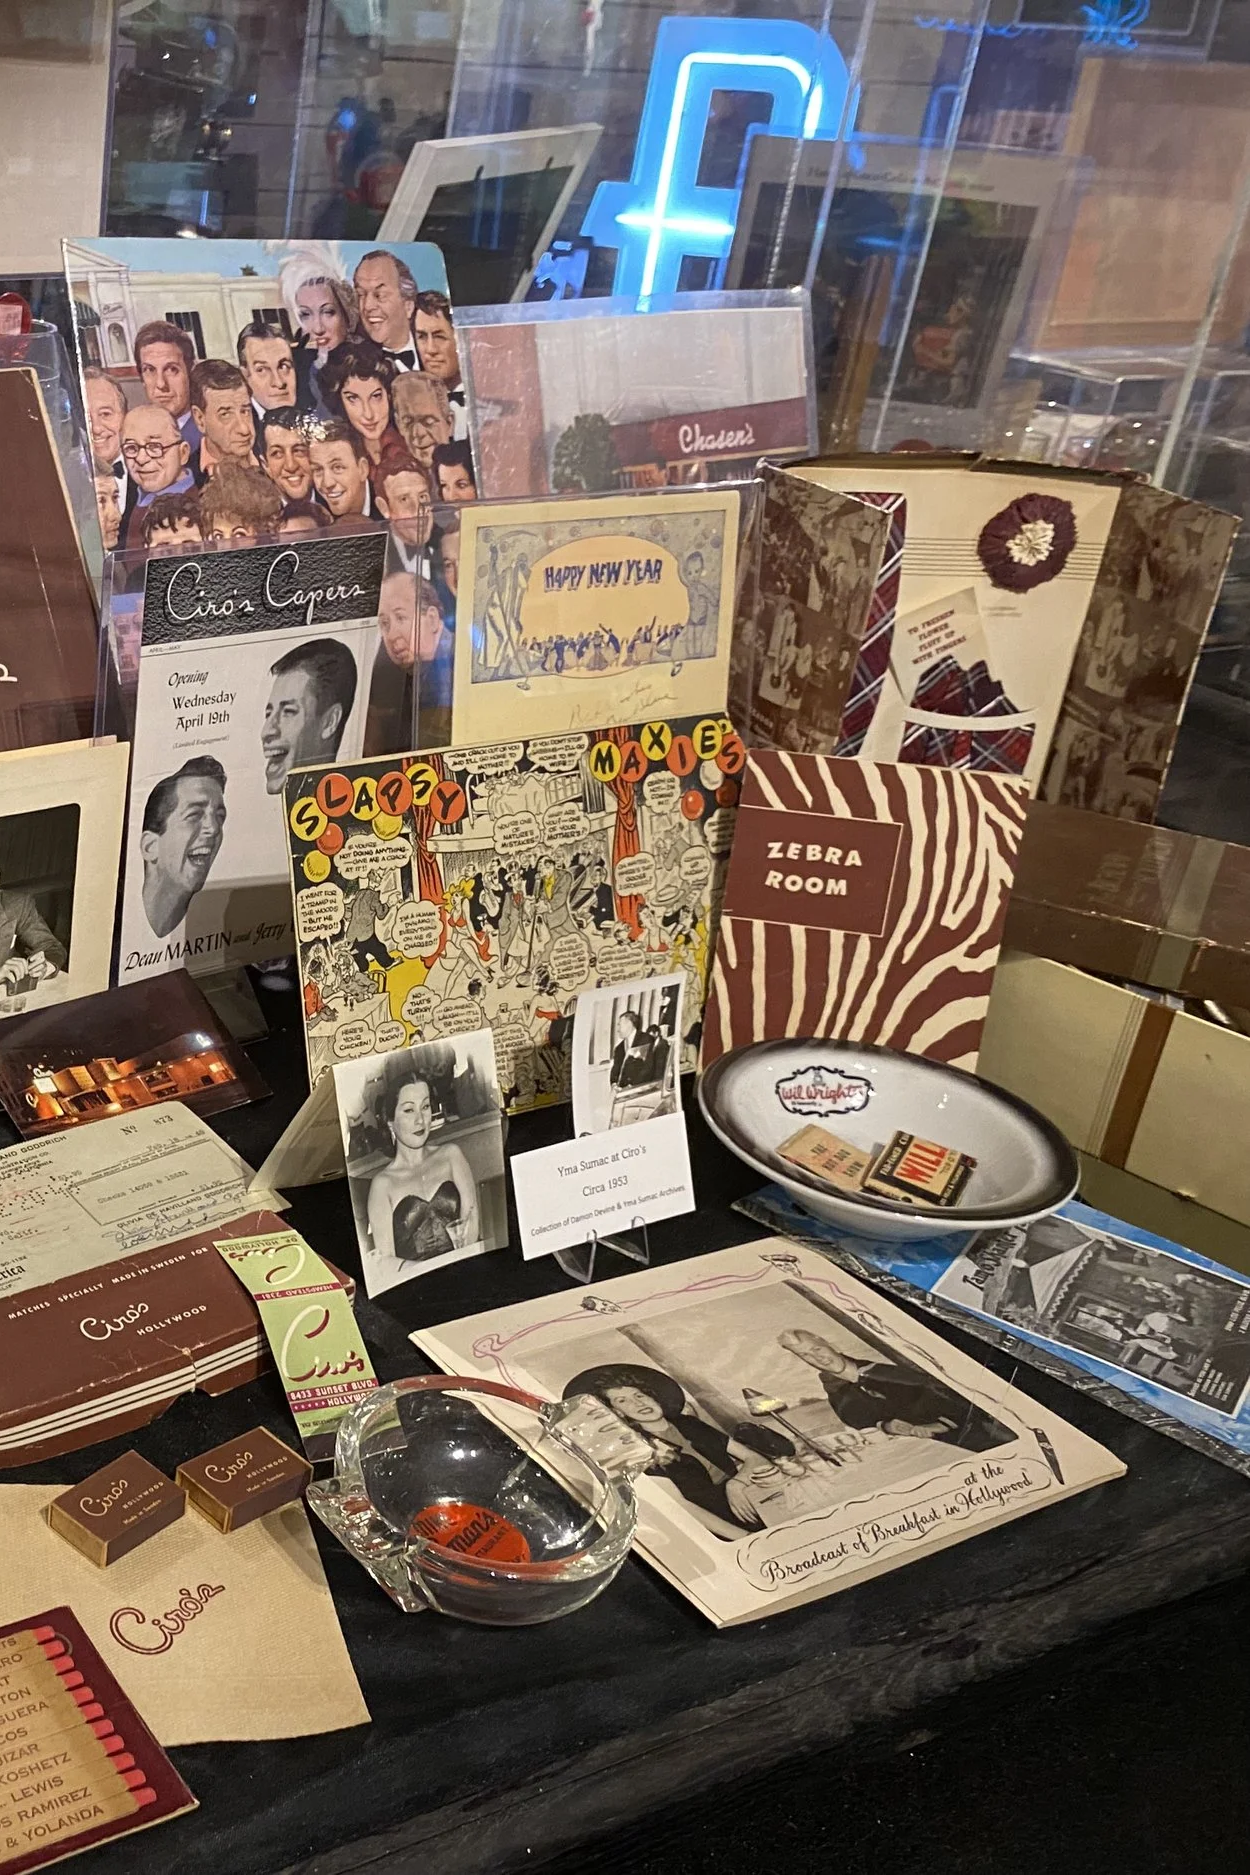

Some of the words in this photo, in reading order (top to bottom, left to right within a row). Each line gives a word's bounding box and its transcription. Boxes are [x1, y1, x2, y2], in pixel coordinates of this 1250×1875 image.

[679, 423, 755, 453] Chasen's
[167, 562, 254, 620] Ciro's
[266, 550, 365, 624] Capers
[544, 566, 586, 591] HAPPY
[588, 562, 622, 588] NEW
[624, 559, 662, 584] YEAR
[168, 670, 209, 687] Opening
[172, 691, 237, 710] Wednesday
[176, 714, 204, 730] April
[208, 711, 230, 726] 19th
[295, 768, 462, 835] SLAPSY
[767, 842, 863, 867] ZEBRA
[764, 870, 847, 896] ROOM
[125, 951, 161, 971] Dean
[164, 932, 232, 961] MARTIN
[253, 922, 286, 945] Jerry
[407, 1006, 433, 1014] TURKEY
[20, 1136, 67, 1154] GOODRICH
[557, 1165, 579, 1178] Yma
[580, 1155, 609, 1172] Sumac
[611, 1153, 620, 1162] at
[621, 1144, 647, 1159] Ciro's
[582, 1182, 606, 1197] Circa
[608, 1175, 629, 1189] 1953
[531, 1221, 562, 1237] Collection
[563, 1218, 570, 1226] of
[571, 1211, 594, 1224] Damon
[594, 1205, 616, 1217] Devine
[623, 1199, 637, 1208] Yma
[638, 1192, 658, 1204] Sumac
[659, 1185, 686, 1198] Archives
[8, 1302, 51, 1320] MATCHES
[58, 1282, 104, 1303] SPECIALLY
[111, 1272, 137, 1284] MADE
[138, 1267, 149, 1276] IN
[150, 1254, 186, 1271] SWEDEN
[191, 1246, 209, 1257] FOR
[79, 1302, 149, 1341] Ciro's
[137, 1304, 208, 1336] HOLLYWOOD
[281, 1304, 365, 1383] Ciro's
[290, 1389, 313, 1401] 8433
[316, 1383, 349, 1396] SUNSET
[351, 1379, 376, 1391] BLVD.
[204, 1451, 253, 1483] Ciro's
[246, 1456, 288, 1479] HOLLYWOOD
[964, 1471, 979, 1487] at
[982, 1463, 1005, 1480] the
[79, 1478, 129, 1517] Ciro's
[122, 1481, 165, 1509] HOLLYWOOD
[760, 1543, 850, 1584] Broadcast
[852, 1528, 869, 1551] of
[861, 1510, 942, 1545] Breakfast
[945, 1504, 960, 1516] in
[955, 1471, 1034, 1513] Hollywood
[109, 1583, 226, 1655] Ciro's
[10, 1775, 64, 1802] LEWIS
[17, 1786, 92, 1821] RAMIREZ
[5, 1836, 19, 1850] &
[22, 1804, 105, 1843] YOLANDA
